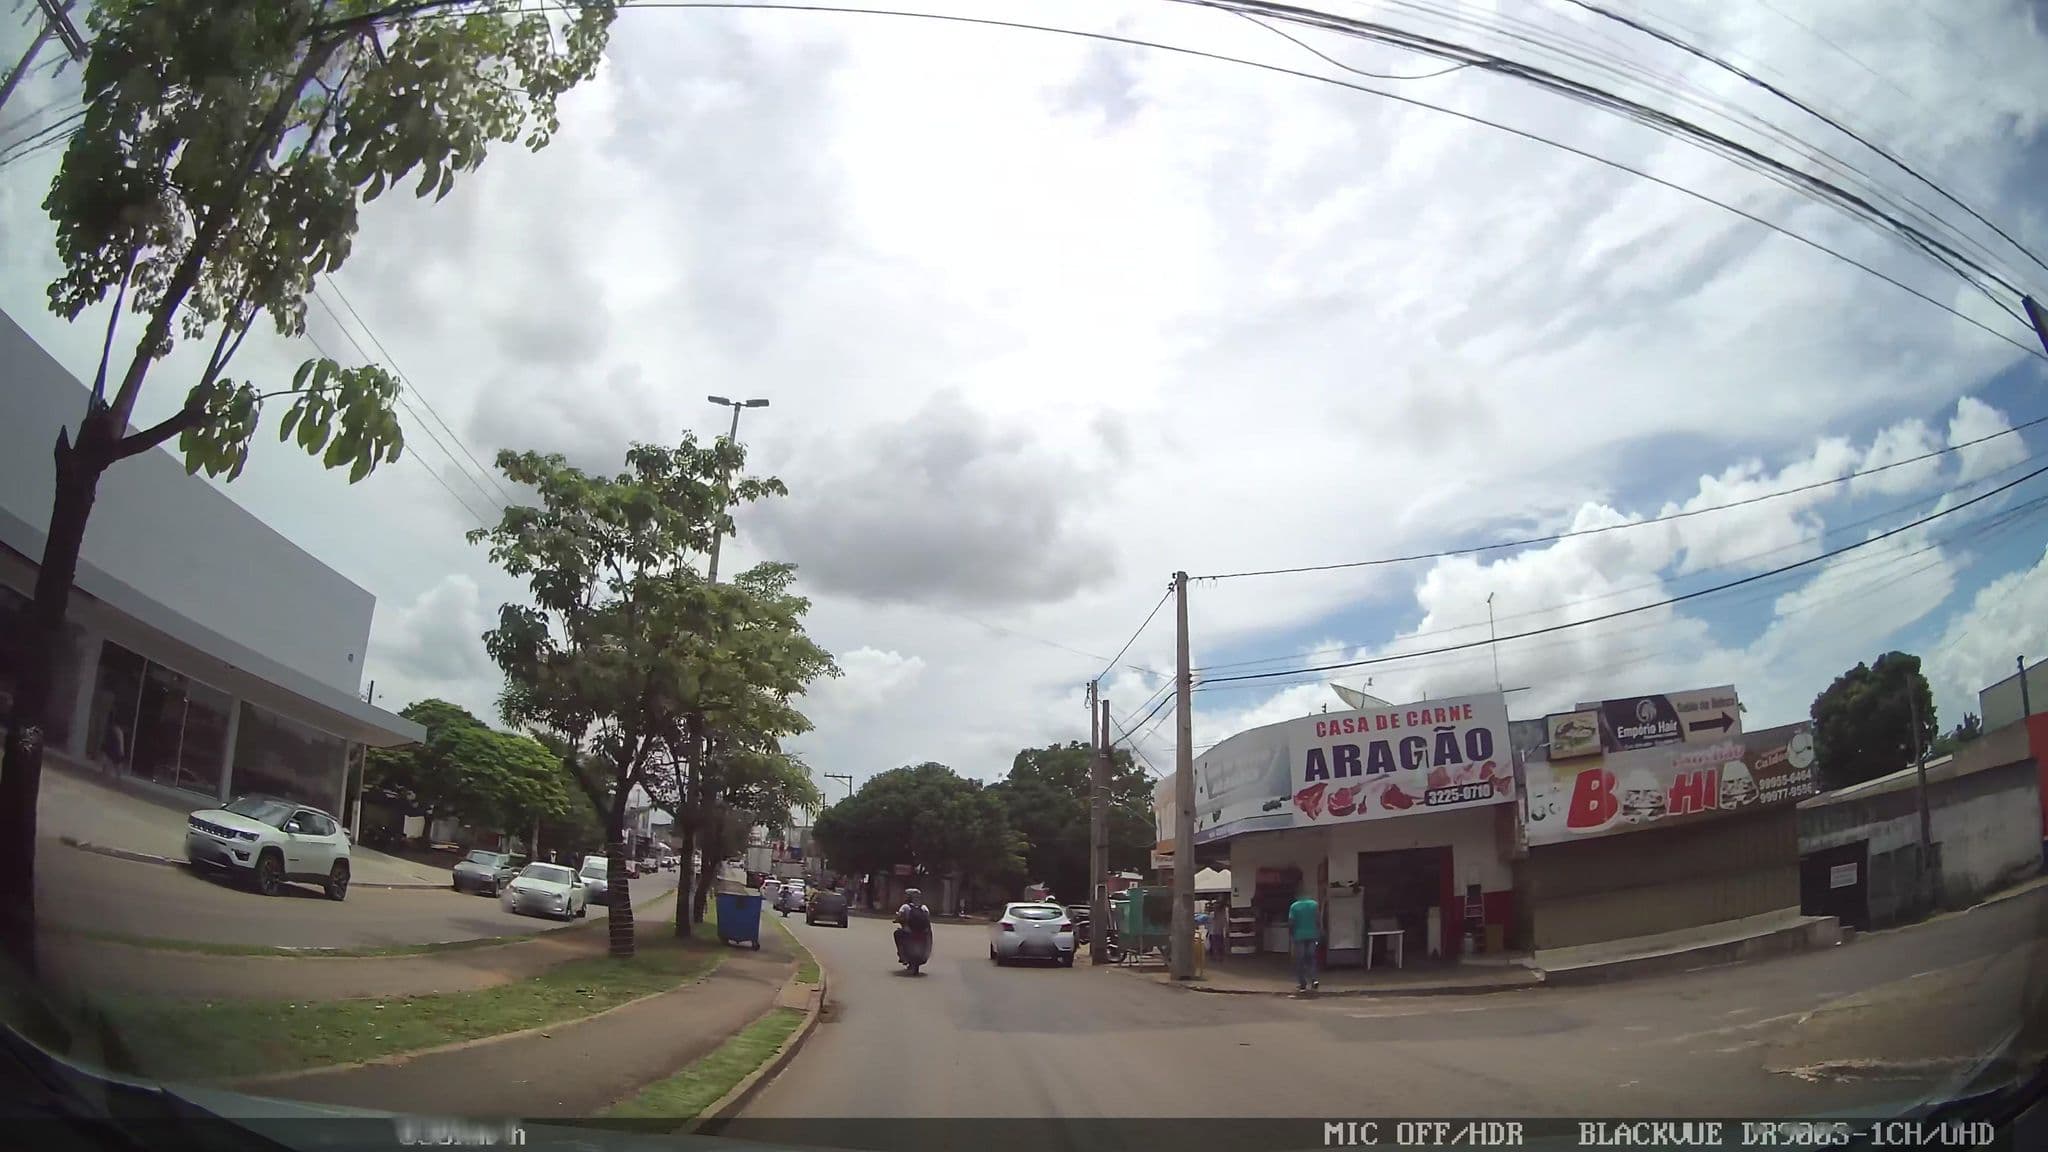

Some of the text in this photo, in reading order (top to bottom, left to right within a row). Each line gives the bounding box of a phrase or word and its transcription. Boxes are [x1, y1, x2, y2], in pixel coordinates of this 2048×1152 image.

[1316, 704, 1473, 738] CASA DE CARNE
[1657, 720, 1678, 733] Hair
[1305, 725, 1494, 782] ARAGÃO
